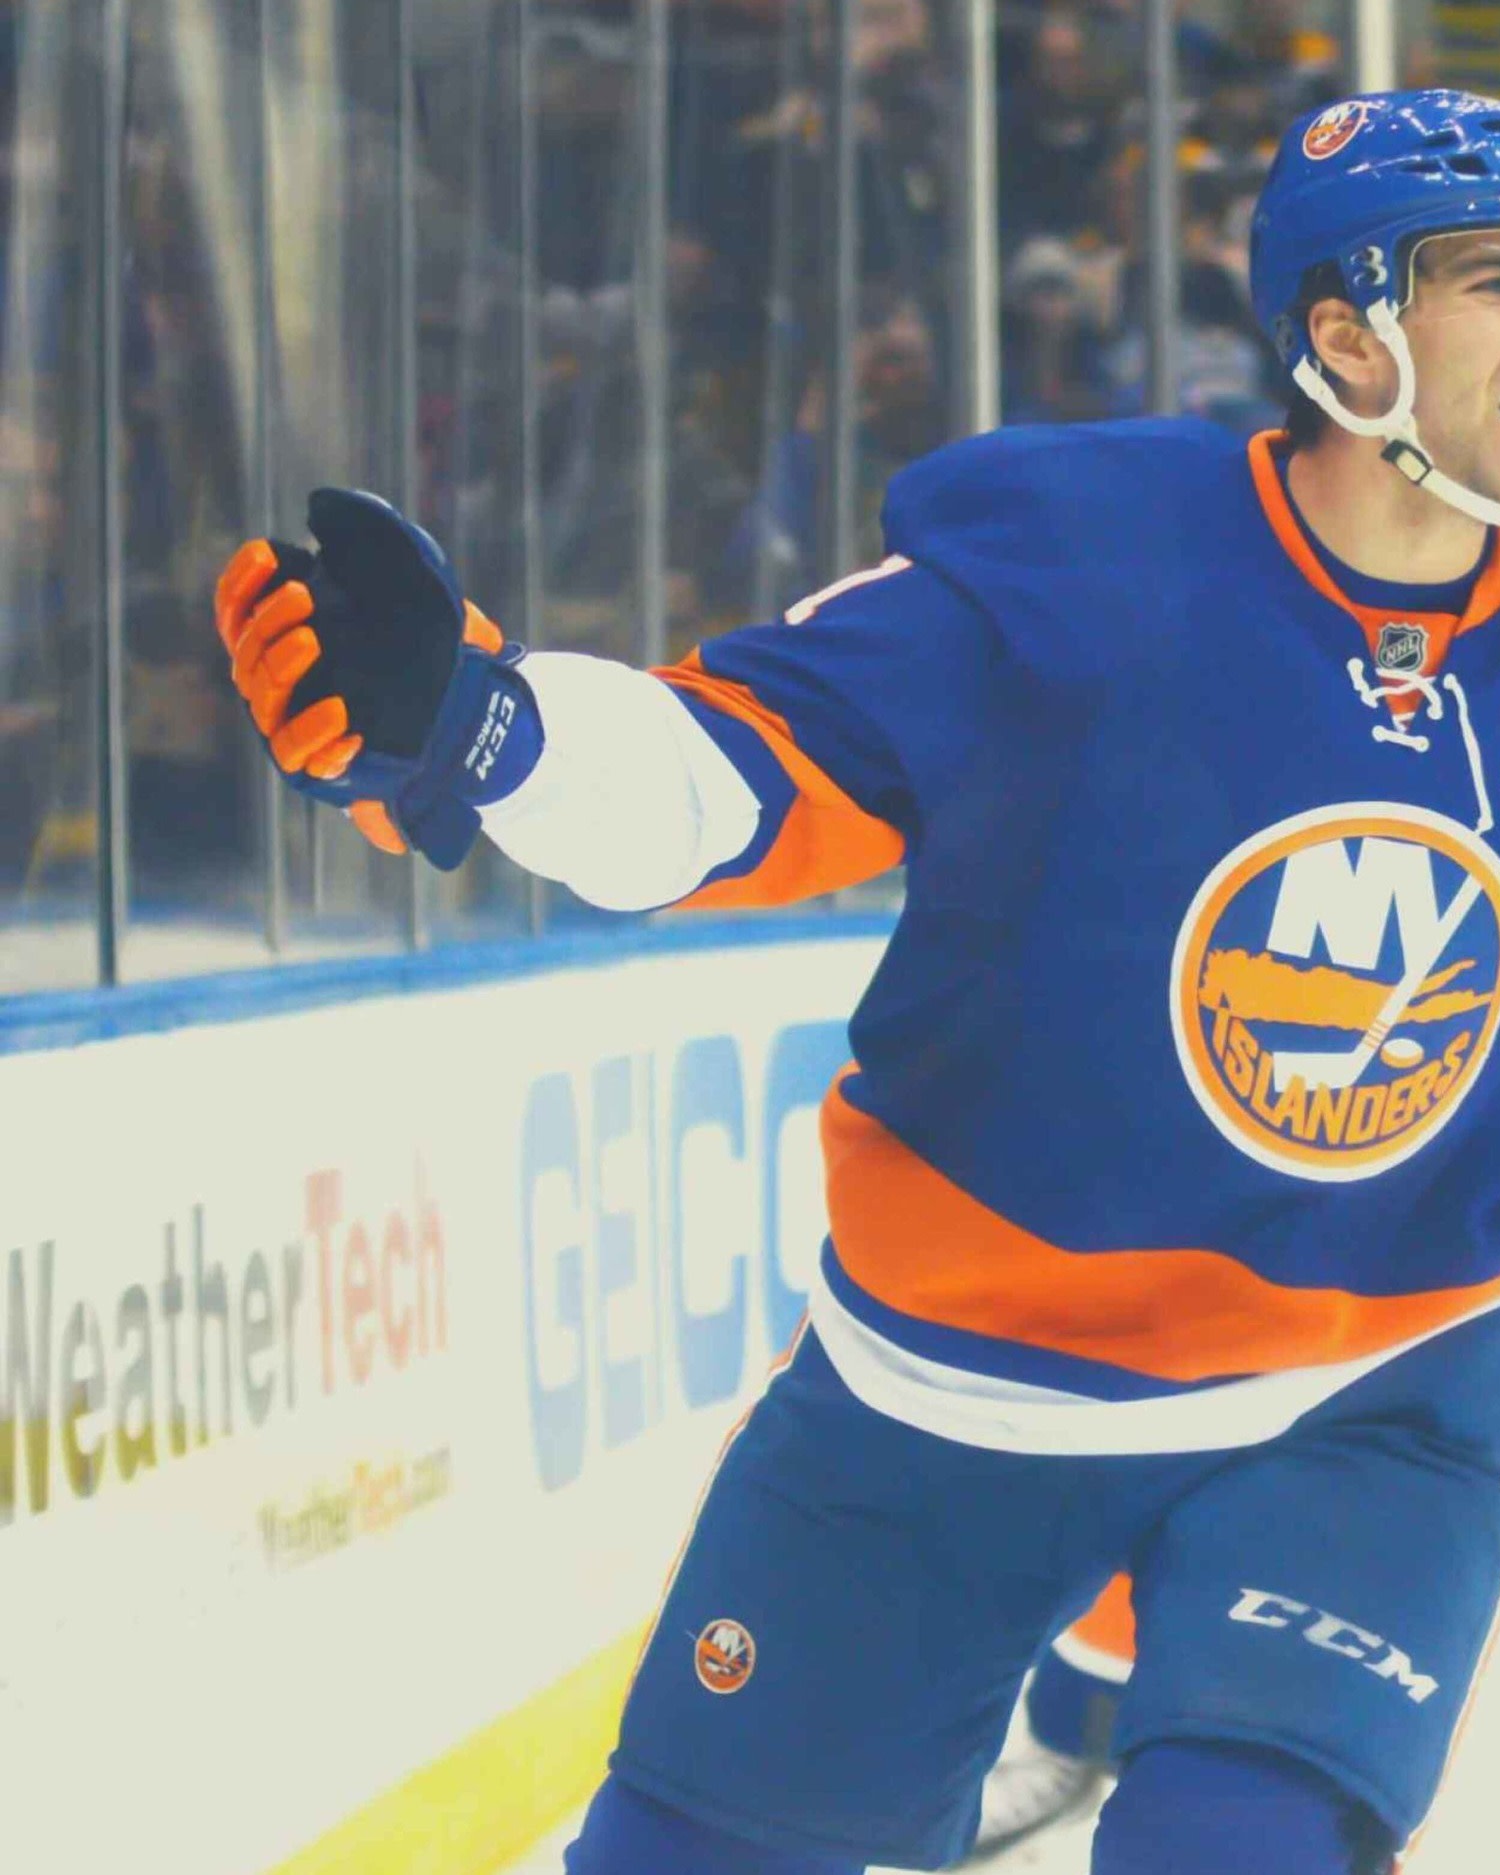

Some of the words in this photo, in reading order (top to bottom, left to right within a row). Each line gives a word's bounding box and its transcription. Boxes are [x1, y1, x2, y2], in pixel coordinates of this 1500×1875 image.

[1382, 635, 1418, 664] NHL
[475, 695, 516, 781] CCM
[1267, 836, 1484, 985] NY
[1212, 1005, 1472, 1146] ISLANDERS
[0, 1152, 448, 1530] WeatherTech
[1228, 1587, 1440, 1704] CCM
